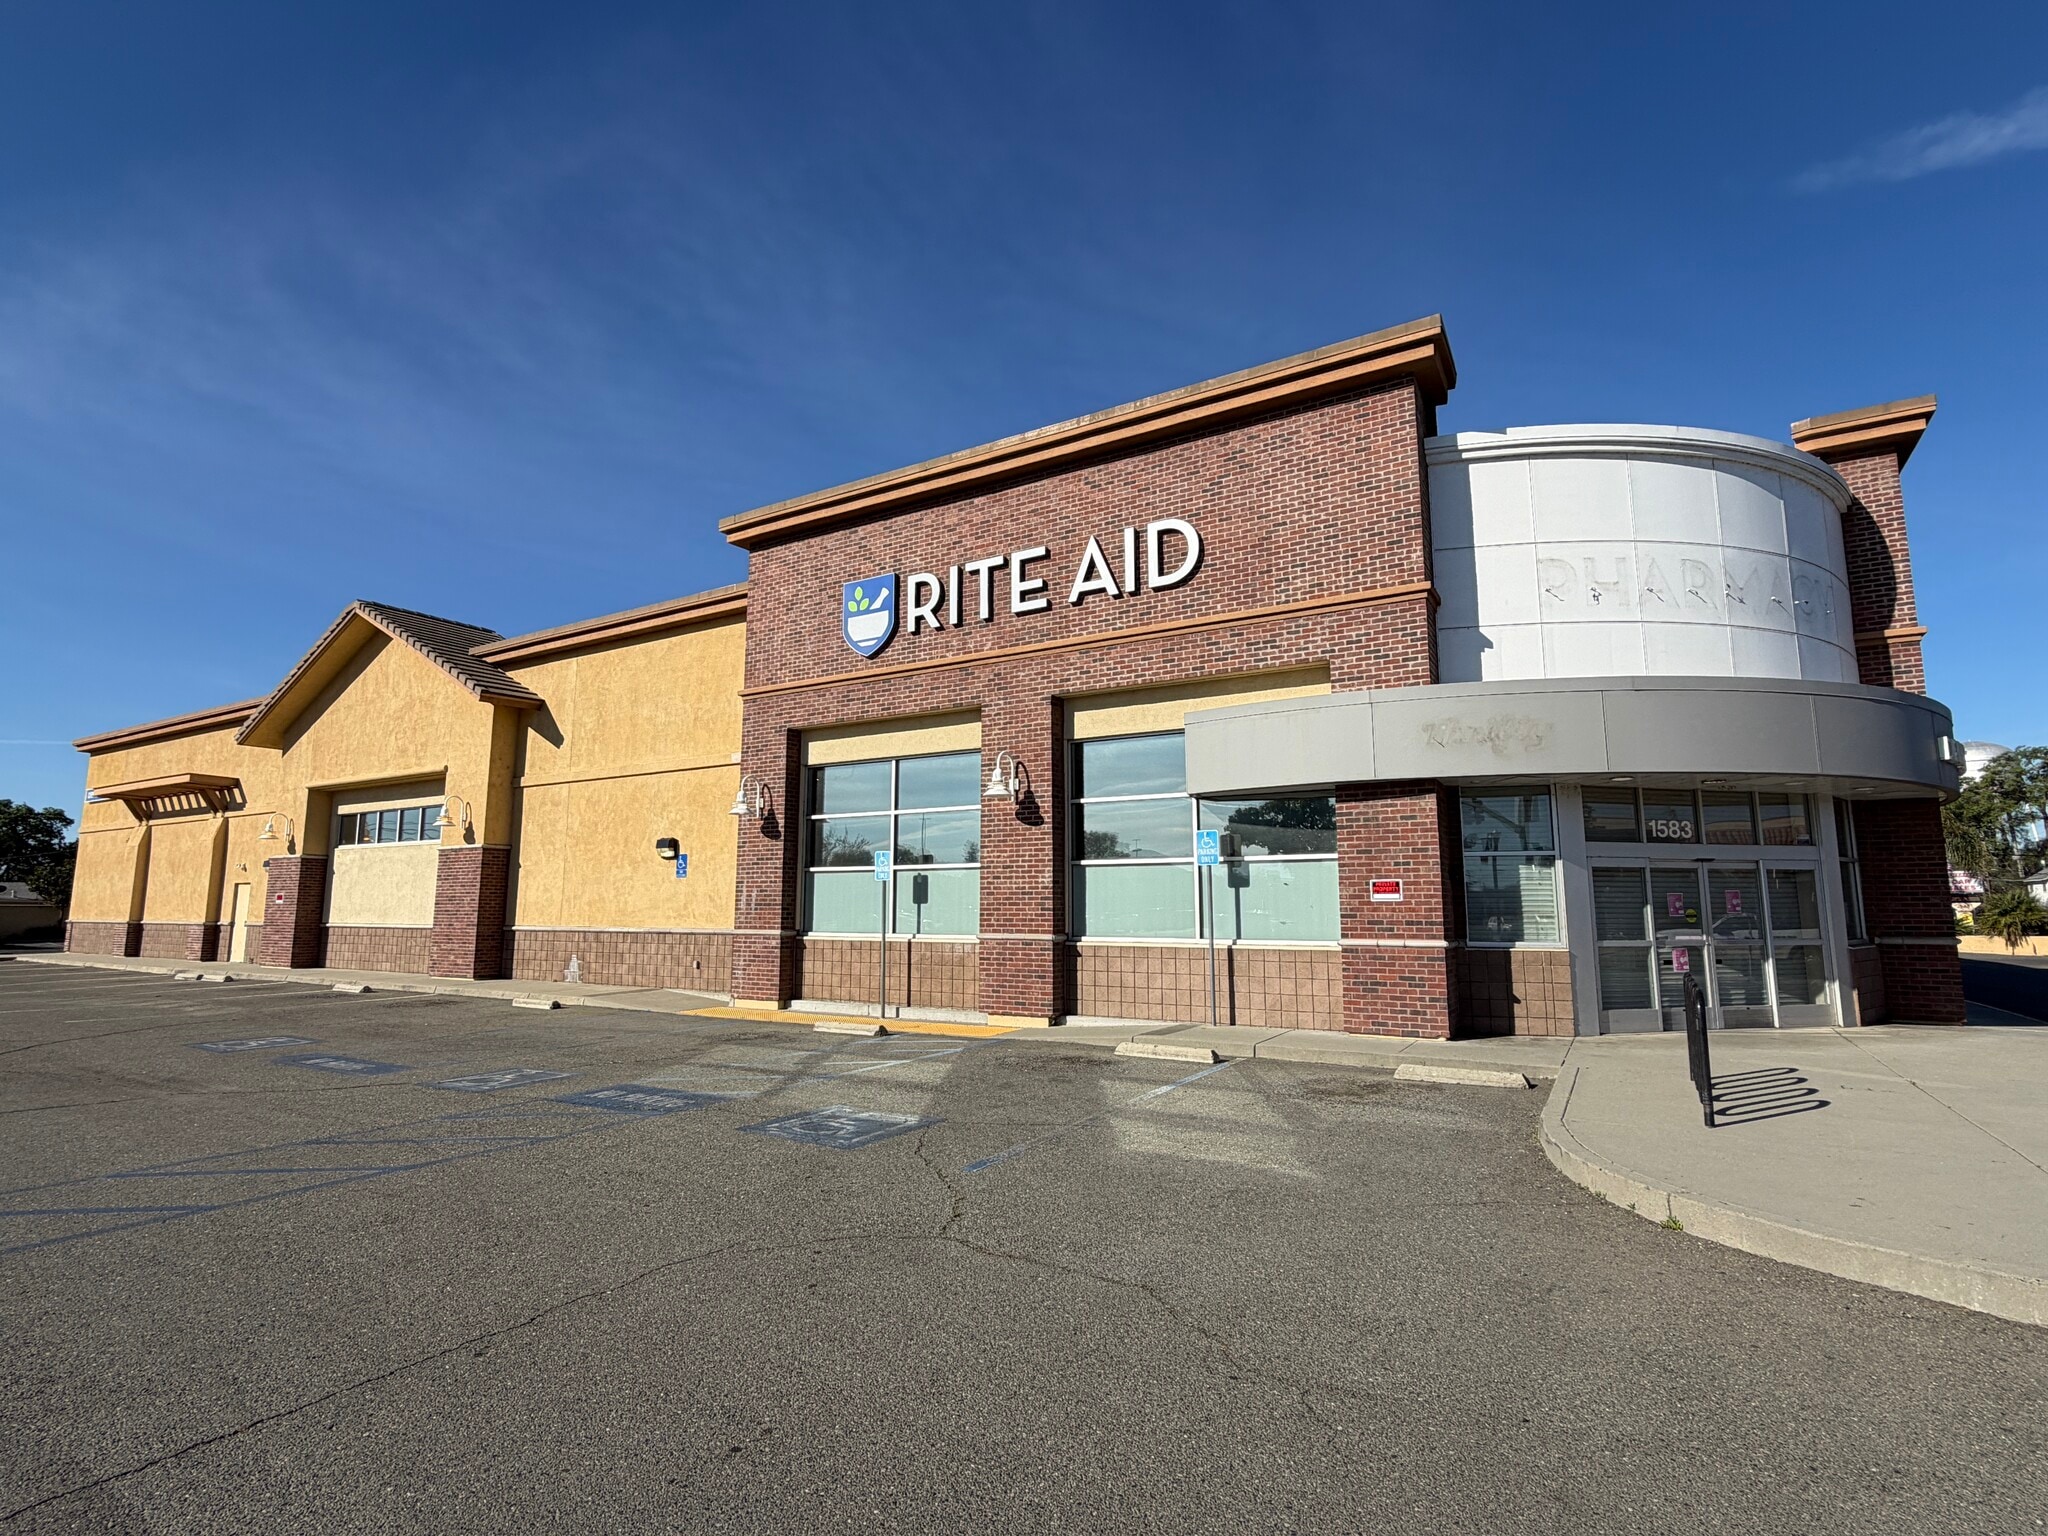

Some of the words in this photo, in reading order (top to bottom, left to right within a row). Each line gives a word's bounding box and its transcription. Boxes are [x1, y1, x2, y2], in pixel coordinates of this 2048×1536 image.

[906, 546, 1050, 633] RITE
[1068, 518, 1201, 604] AID
[1648, 819, 1692, 839] 1583
[1201, 855, 1215, 863] ONLY
